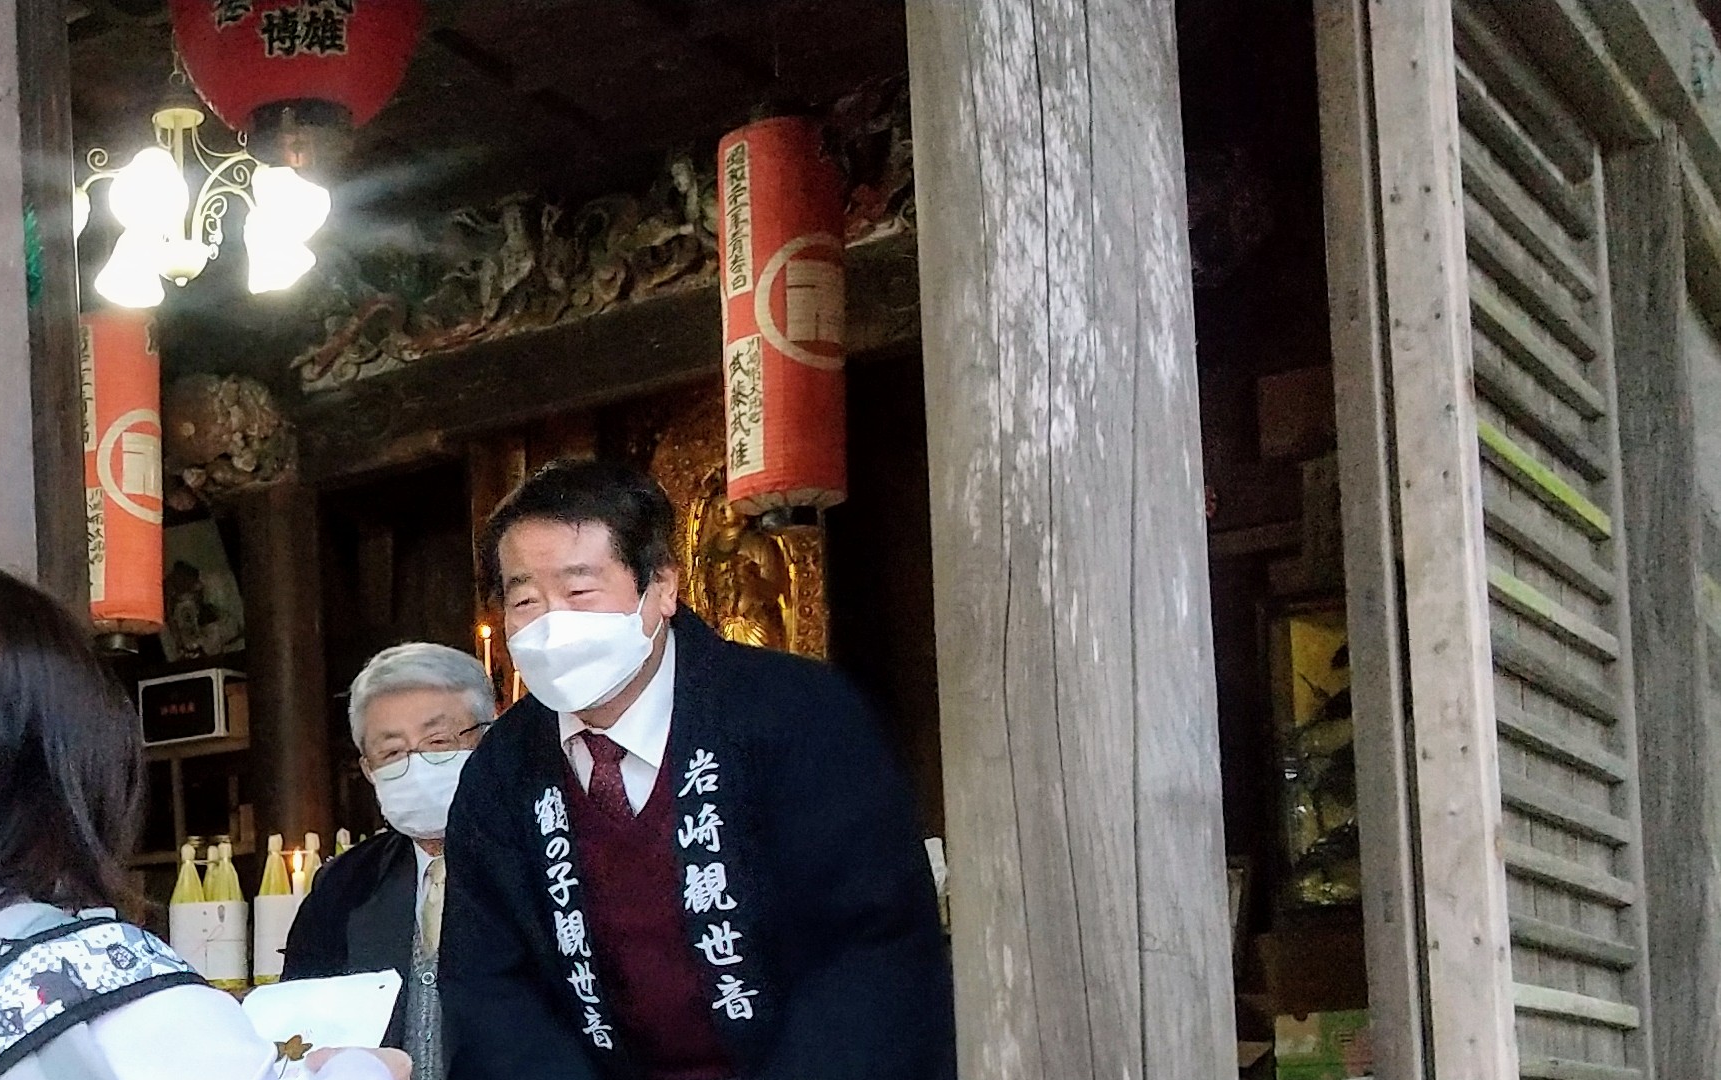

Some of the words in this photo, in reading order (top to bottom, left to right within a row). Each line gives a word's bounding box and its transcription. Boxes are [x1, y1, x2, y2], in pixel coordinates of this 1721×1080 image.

[533, 786, 613, 1050] 鶴の子観世音
[676, 747, 760, 1021] 岩崎観世音
